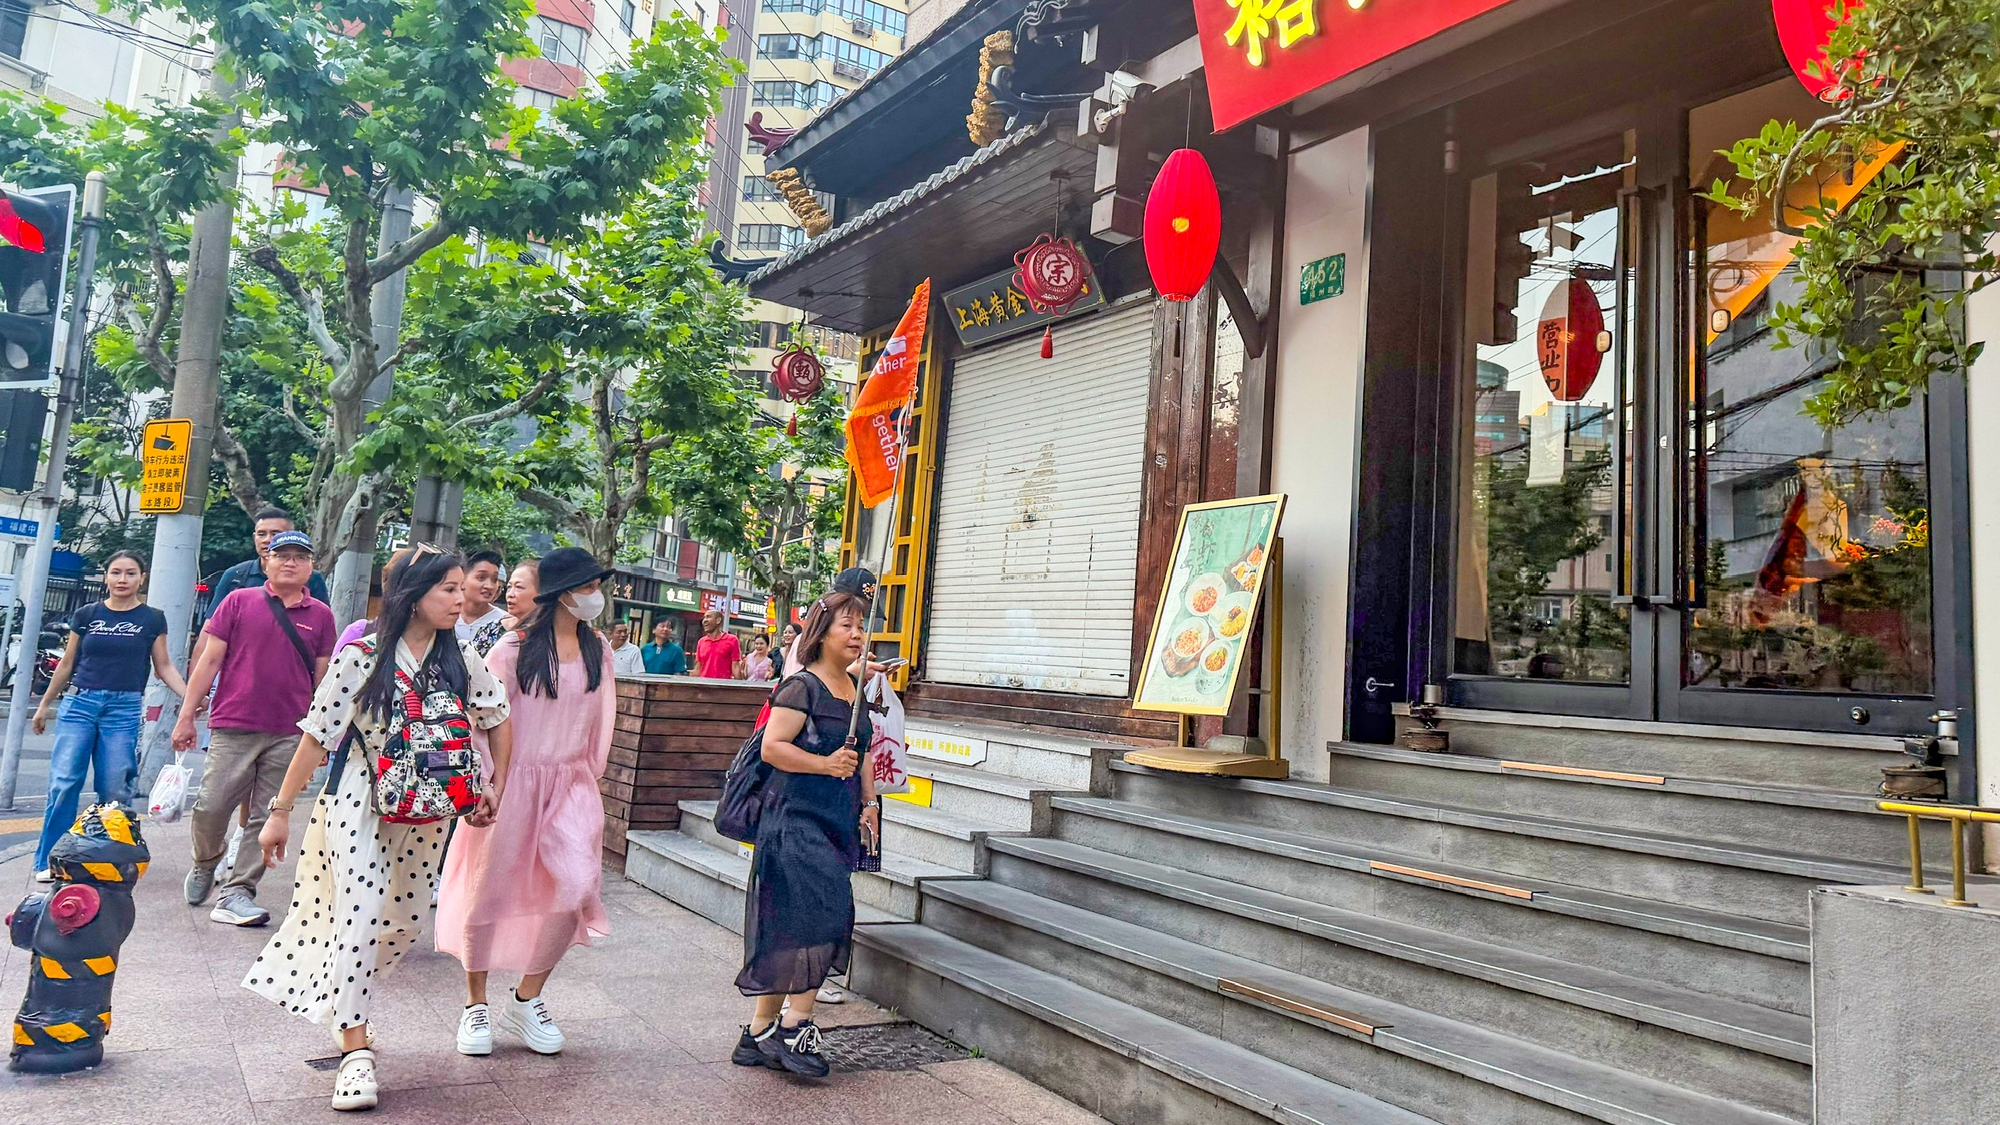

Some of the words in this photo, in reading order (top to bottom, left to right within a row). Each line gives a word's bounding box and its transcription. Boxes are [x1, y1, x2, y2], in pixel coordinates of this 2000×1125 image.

[1046, 253, 1070, 285] 宗
[1304, 260, 1338, 285] 452
[873, 749, 903, 784] 酥
